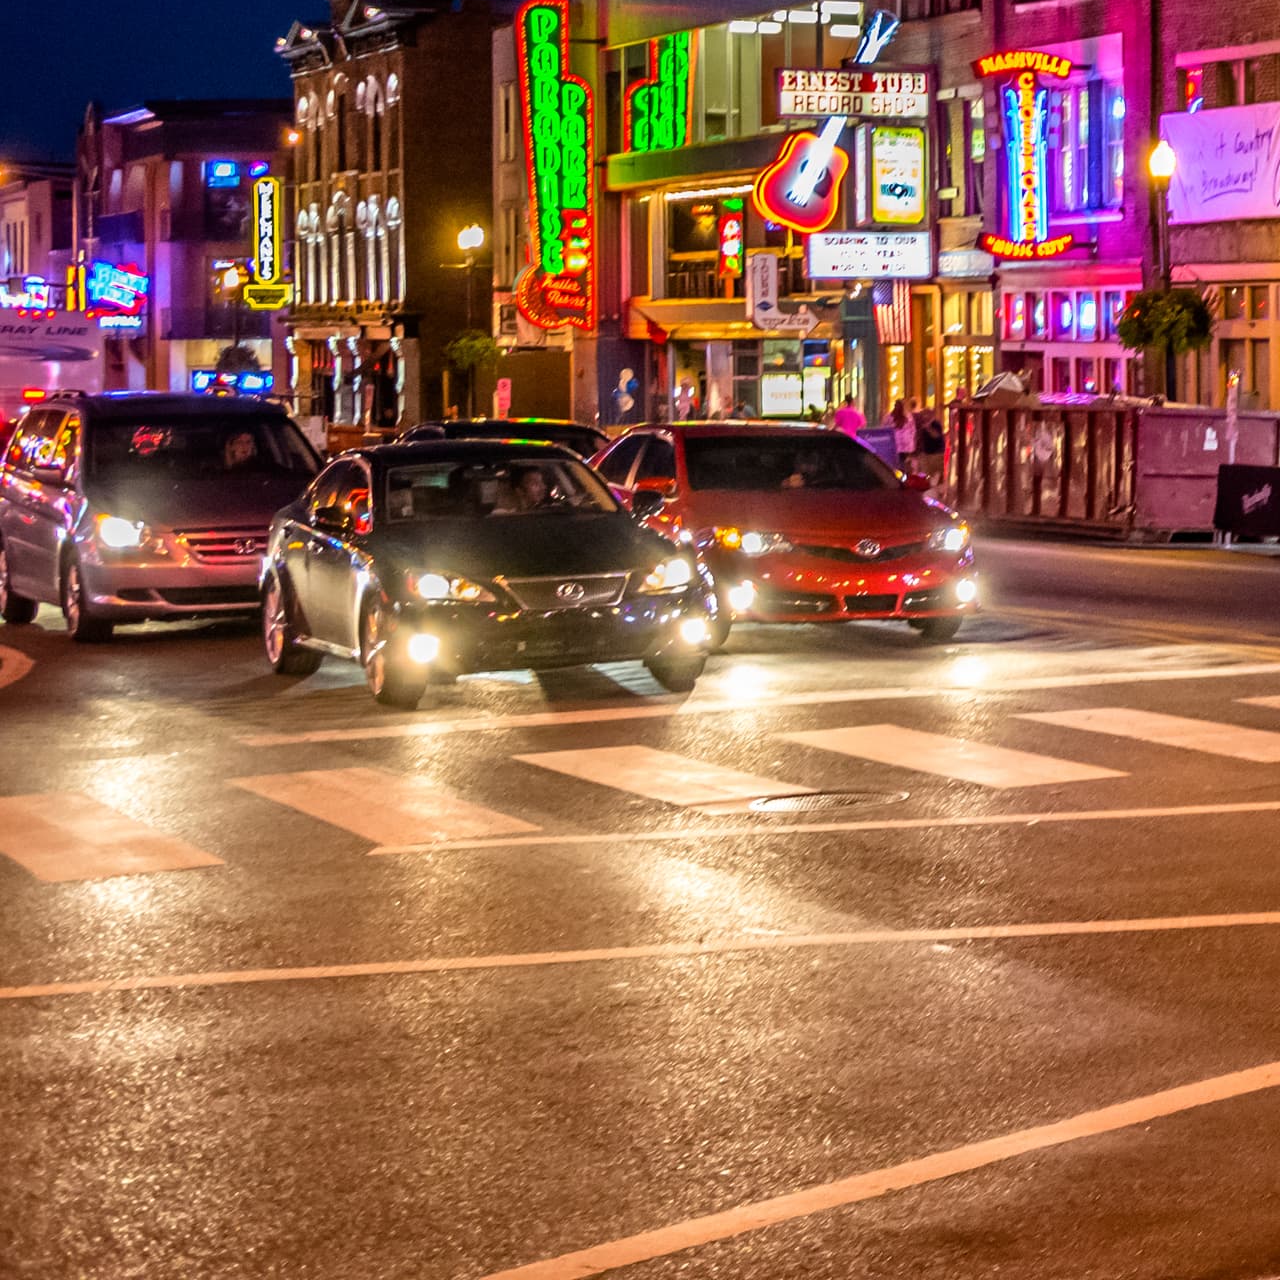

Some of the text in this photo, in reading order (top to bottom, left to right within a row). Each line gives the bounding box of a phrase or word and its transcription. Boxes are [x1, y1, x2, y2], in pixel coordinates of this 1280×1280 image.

[782, 71, 927, 93] ERNEST TUBB
[980, 52, 1071, 77] NASHVILLE
[793, 95, 917, 115] RECORD SHOP
[531, 7, 563, 275] PARADISE
[560, 83, 586, 208] PARK
[1019, 72, 1037, 241] CROSSROADS
[1233, 126, 1275, 161] Country
[257, 182, 274, 281] MERCHANTS
[0, 324, 88, 336] RAY LINE
